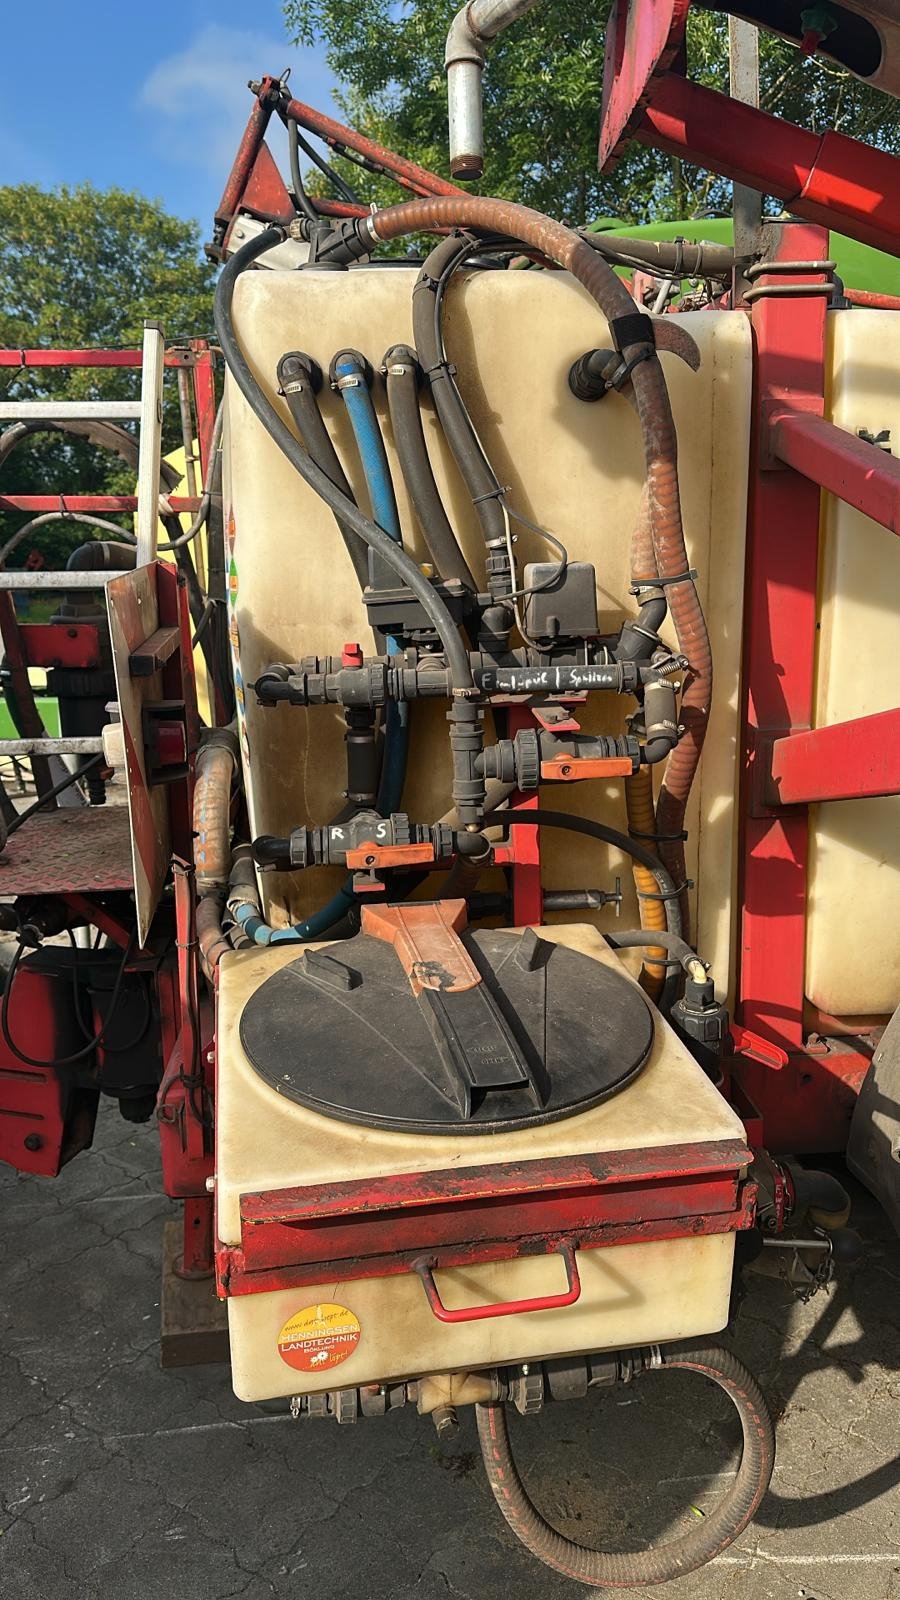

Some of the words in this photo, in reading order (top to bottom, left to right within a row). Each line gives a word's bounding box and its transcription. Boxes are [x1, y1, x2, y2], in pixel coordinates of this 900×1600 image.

[331, 827, 345, 840] R
[376, 823, 386, 838] S
[281, 1324, 359, 1342] HENNINGSEN
[281, 1333, 357, 1352] LANDTECHNIK
